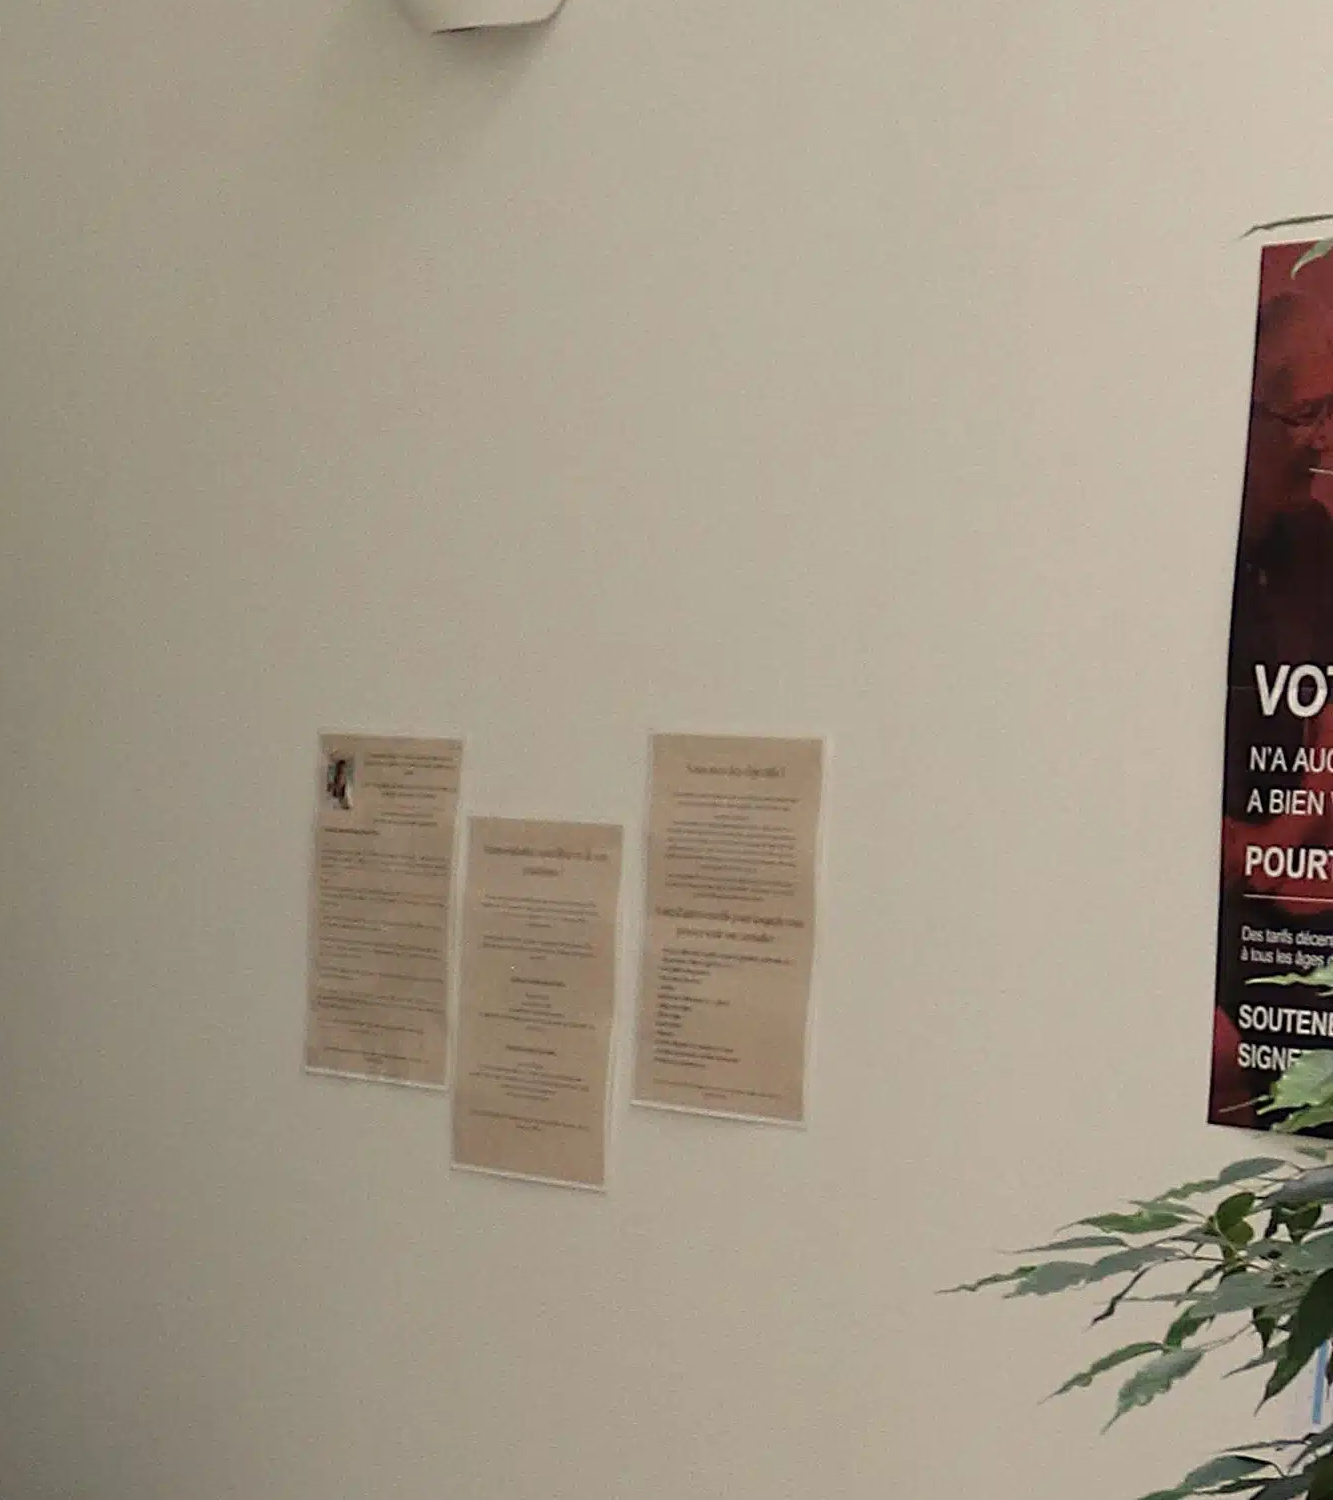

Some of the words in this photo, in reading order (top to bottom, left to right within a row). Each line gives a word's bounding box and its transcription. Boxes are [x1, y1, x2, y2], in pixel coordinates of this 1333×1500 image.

[1254, 663, 1333, 717] VO
[1249, 745, 1288, 773] N'A
[1246, 787, 1264, 814] A
[1268, 788, 1325, 817] BIEN
[1244, 844, 1333, 881] POUR
[1241, 925, 1264, 943] Des
[1265, 927, 1294, 945] tarifs
[1250, 948, 1274, 964] tous
[1275, 948, 1293, 965] les
